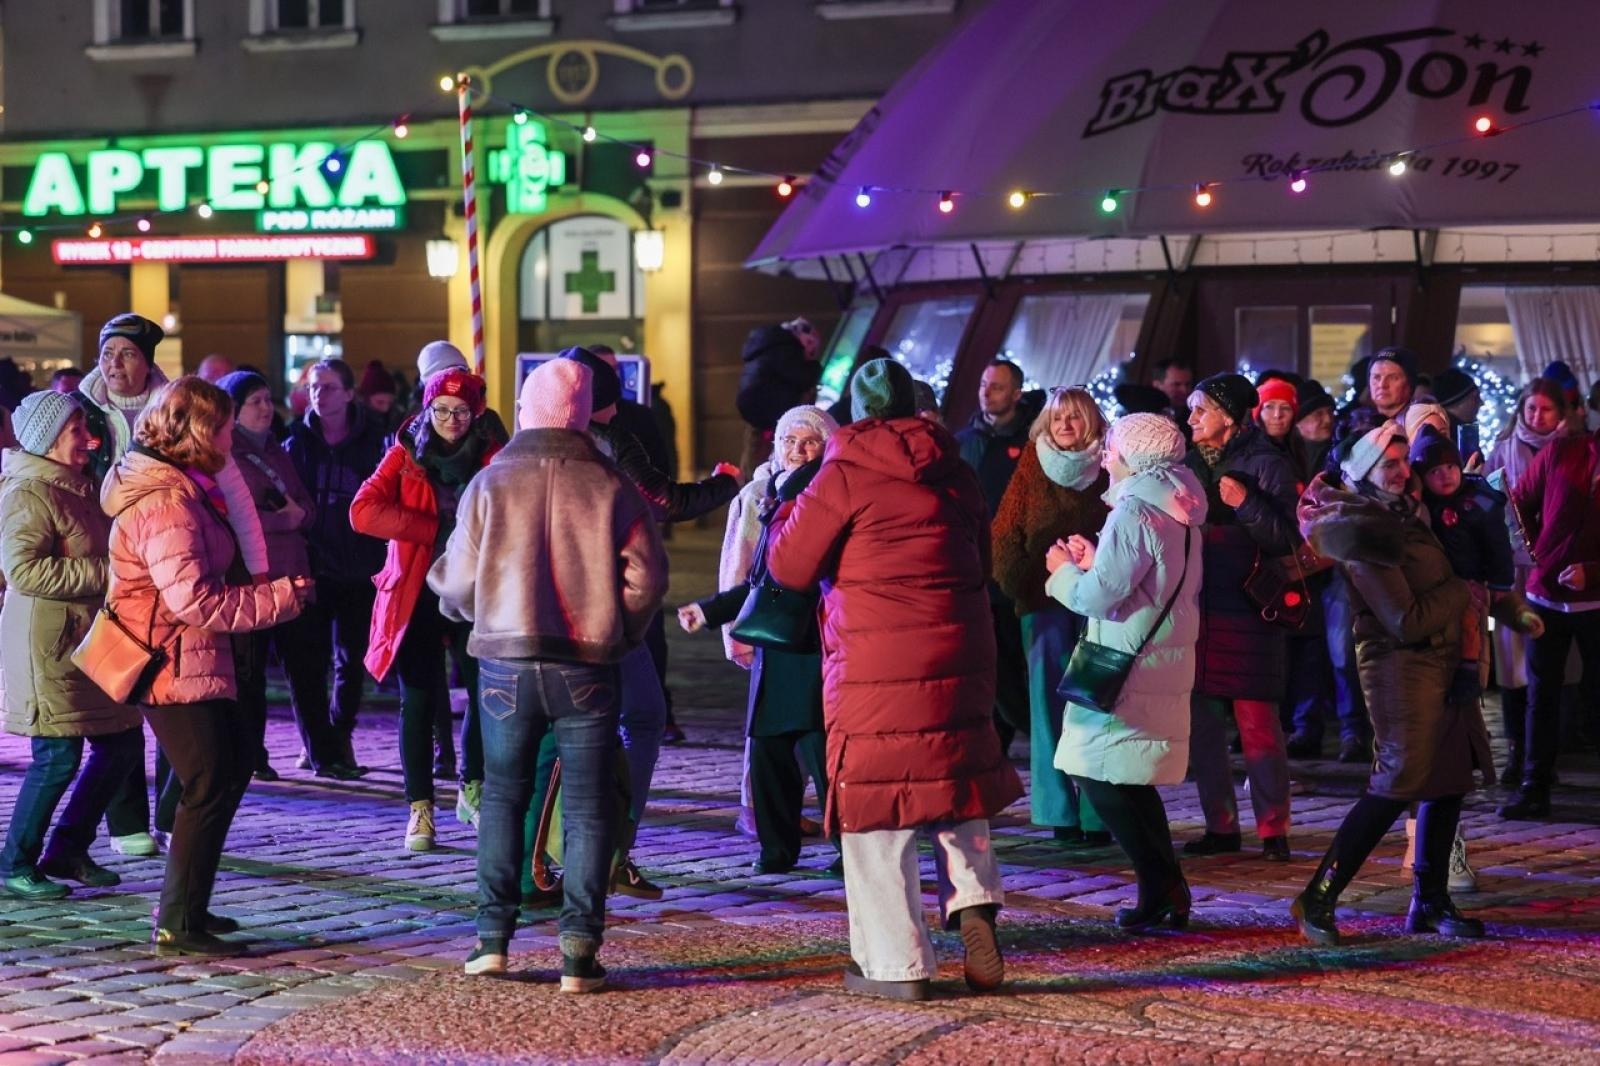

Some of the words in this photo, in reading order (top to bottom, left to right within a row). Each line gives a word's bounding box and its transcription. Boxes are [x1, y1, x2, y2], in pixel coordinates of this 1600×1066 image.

[23, 140, 406, 216] APTEKA
[1242, 151, 1302, 181] Rok
[1442, 156, 1521, 183] 1997
[263, 210, 309, 230] POD
